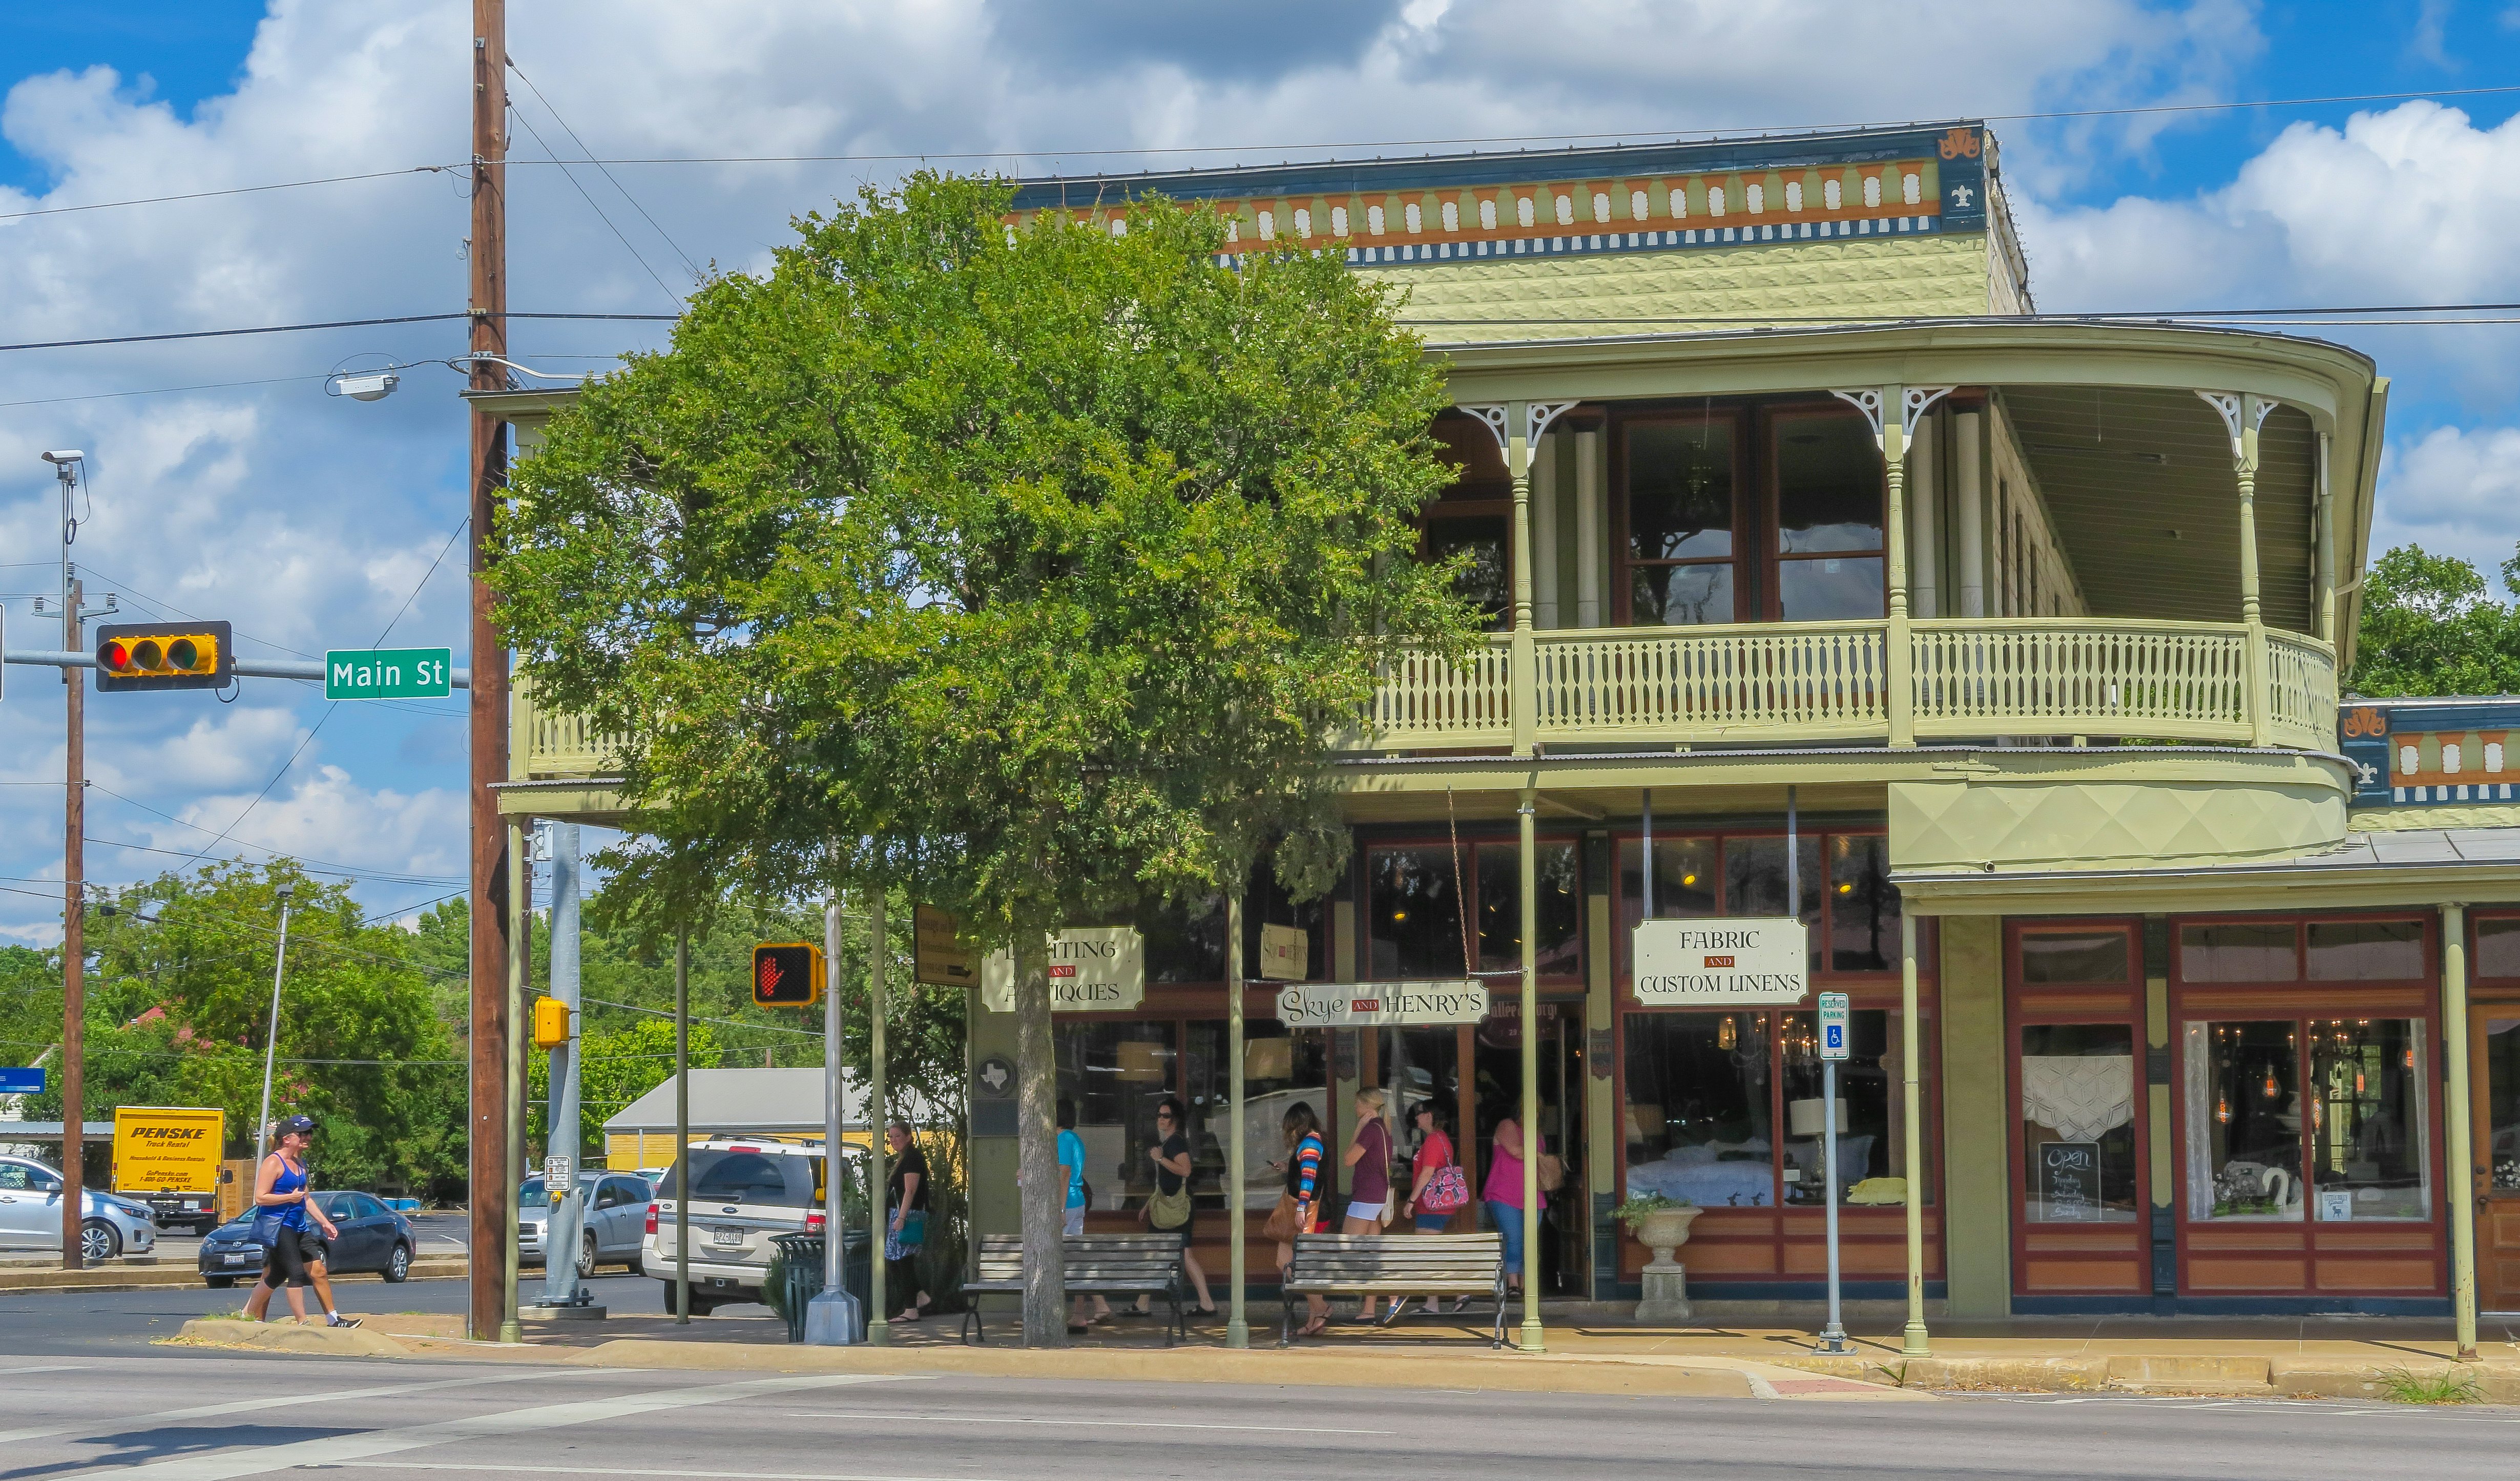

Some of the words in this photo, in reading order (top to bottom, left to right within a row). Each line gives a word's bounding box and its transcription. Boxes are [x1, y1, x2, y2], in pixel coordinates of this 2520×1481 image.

[334, 660, 400, 687] Main
[416, 660, 443, 685] St
[1679, 930, 1761, 950] FABRIC
[1707, 957, 1732, 966] AND
[1051, 967, 1073, 976] AND
[1640, 974, 1721, 994] CUSTOM
[1728, 973, 1801, 993] LINENS
[1282, 987, 1345, 1024] Skye
[1354, 1001, 1377, 1010] AND
[1385, 992, 1482, 1016] HENRY'S
[1822, 1000, 1846, 1008] RESERVED
[1823, 1011, 1845, 1019] PARKING
[131, 1127, 207, 1139] PENSKE
[2047, 1149, 2091, 1175] Open
